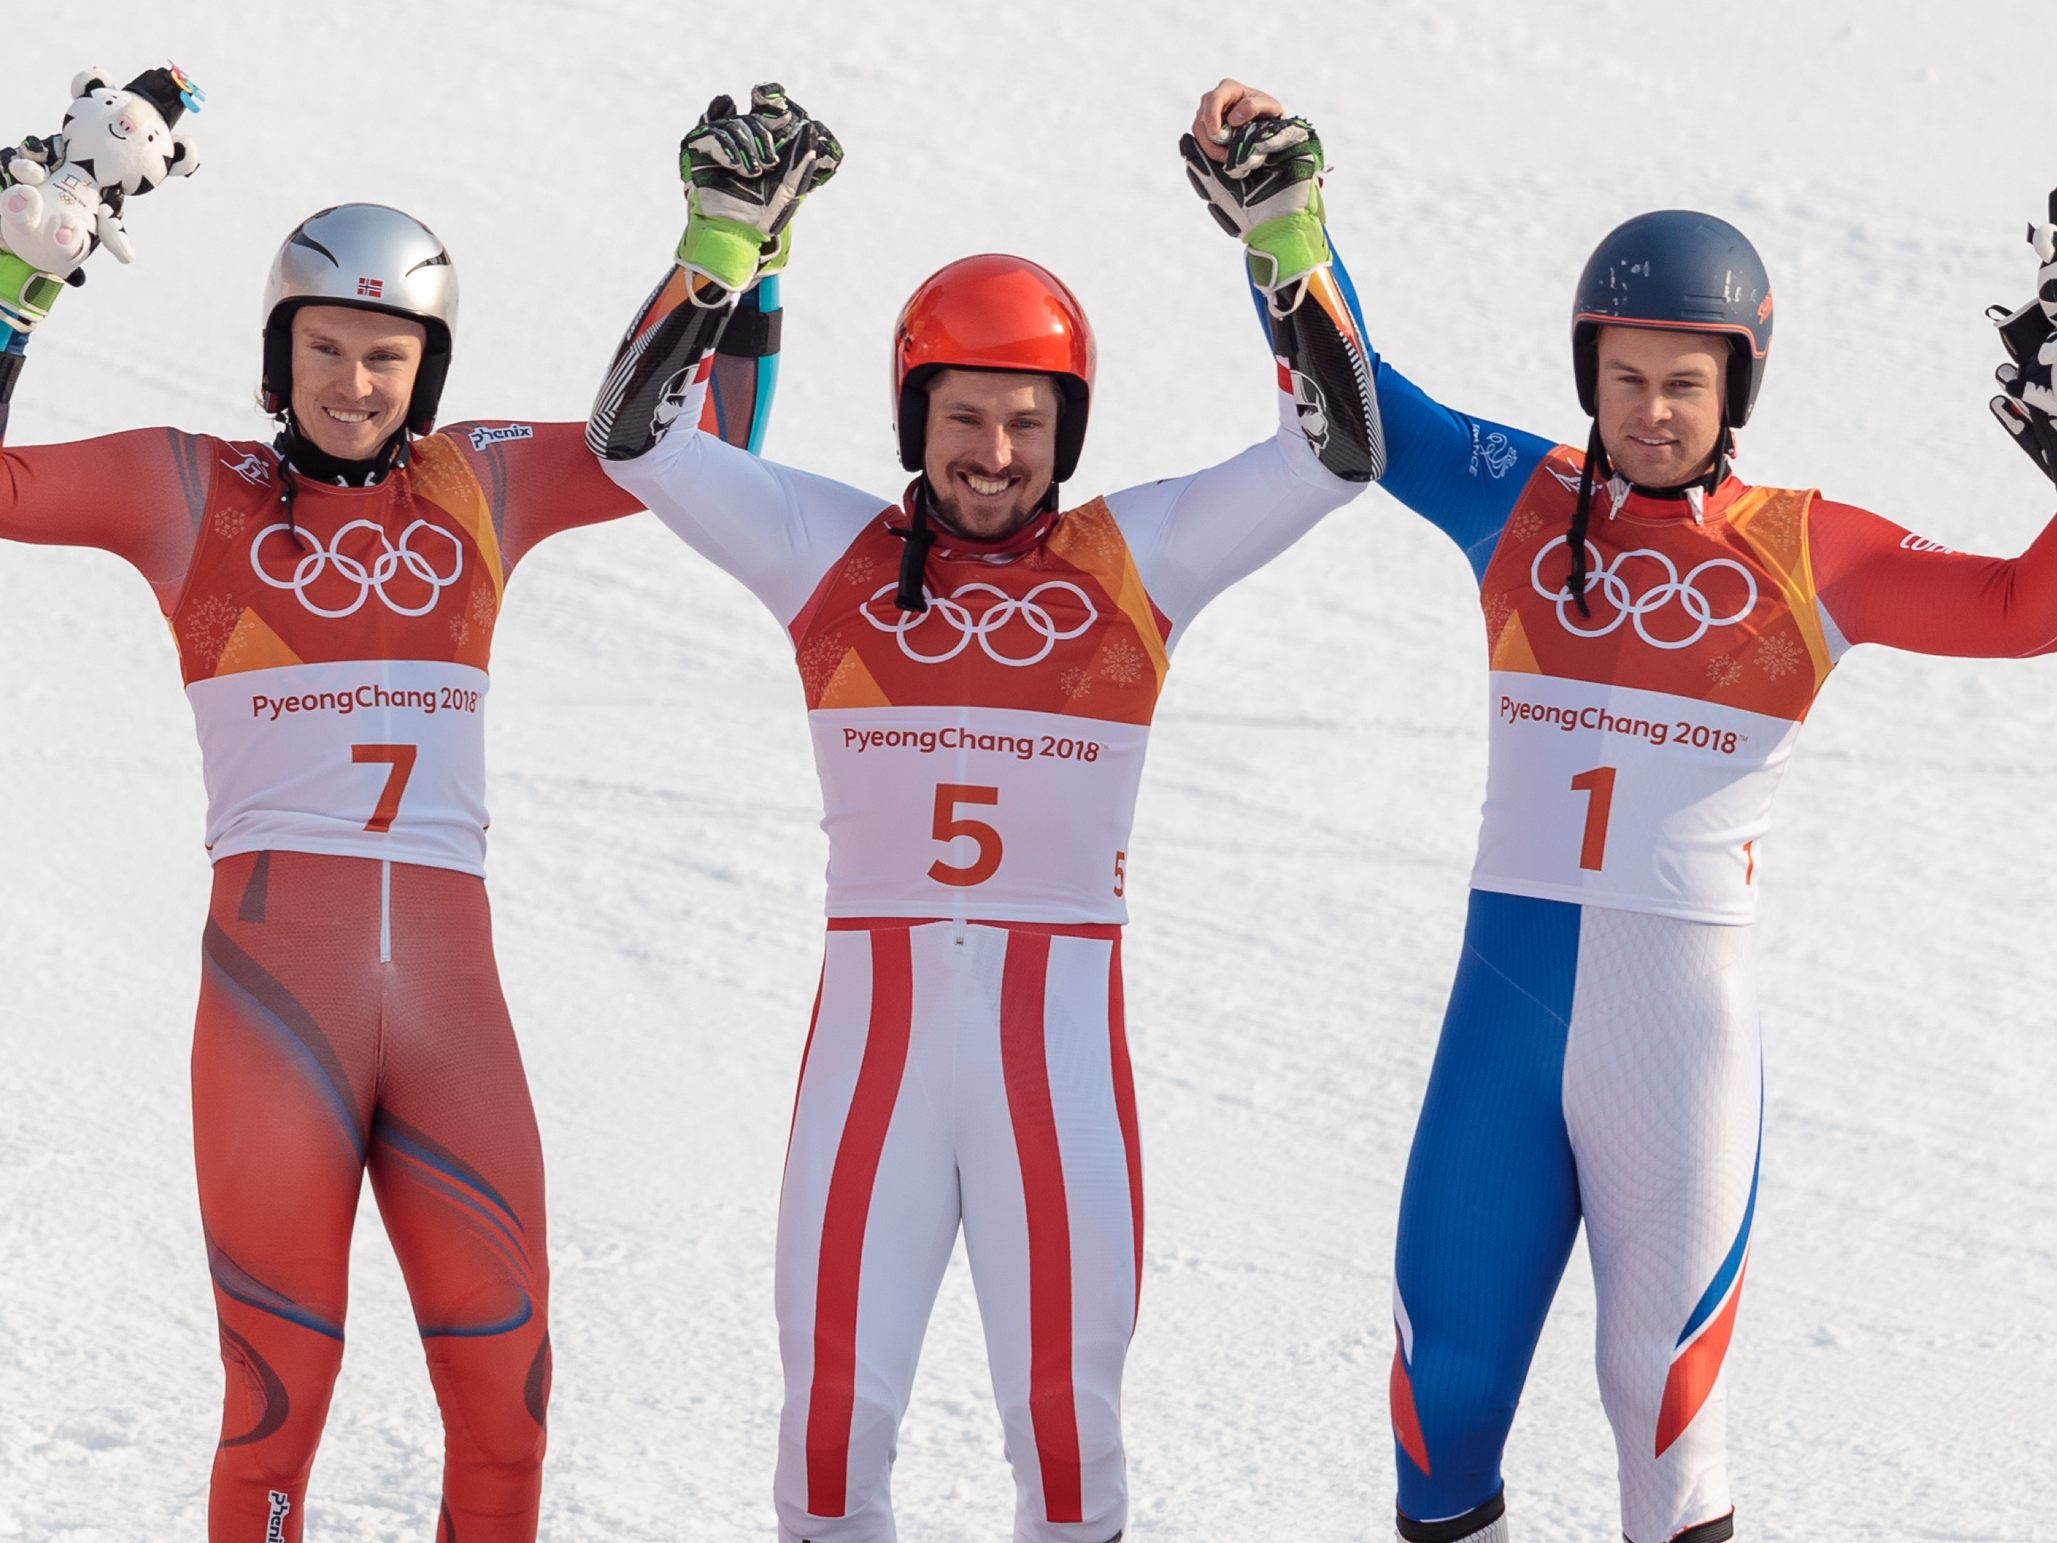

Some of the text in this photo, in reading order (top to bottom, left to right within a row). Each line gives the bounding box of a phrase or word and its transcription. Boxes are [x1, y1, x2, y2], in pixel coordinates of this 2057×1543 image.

[252, 685, 478, 721] PyeongChang 2018
[1500, 696, 1669, 746] PyeongChang
[1672, 721, 1738, 755] 2018
[842, 728, 1100, 763] PyeongChang 2018
[351, 744, 417, 833] 7
[926, 783, 1004, 887] 5
[1570, 766, 1617, 872] 1
[1113, 851, 1126, 898] 5
